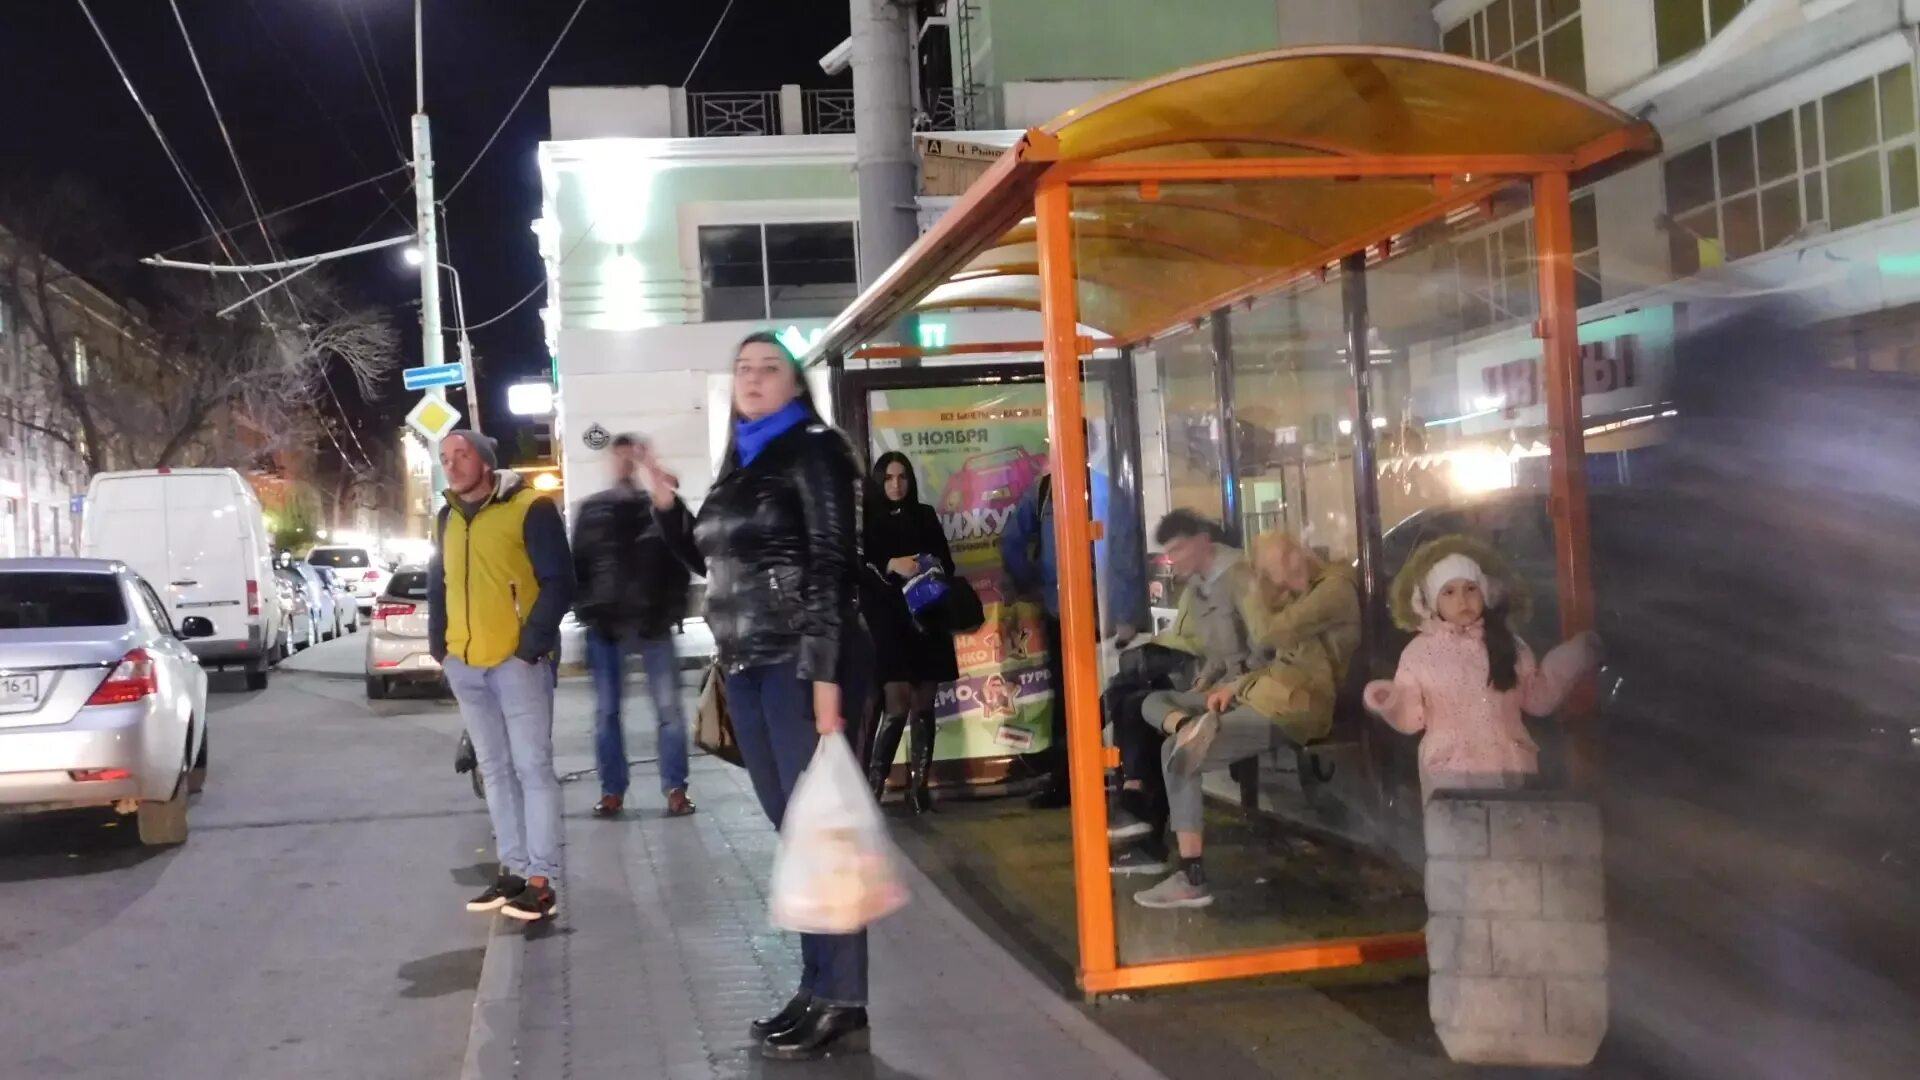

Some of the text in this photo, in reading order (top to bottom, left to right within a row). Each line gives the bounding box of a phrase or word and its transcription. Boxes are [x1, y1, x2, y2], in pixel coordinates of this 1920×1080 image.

[971, 146, 1004, 157] Рыно
[902, 428, 989, 447] 9 НОЯБРЯ
